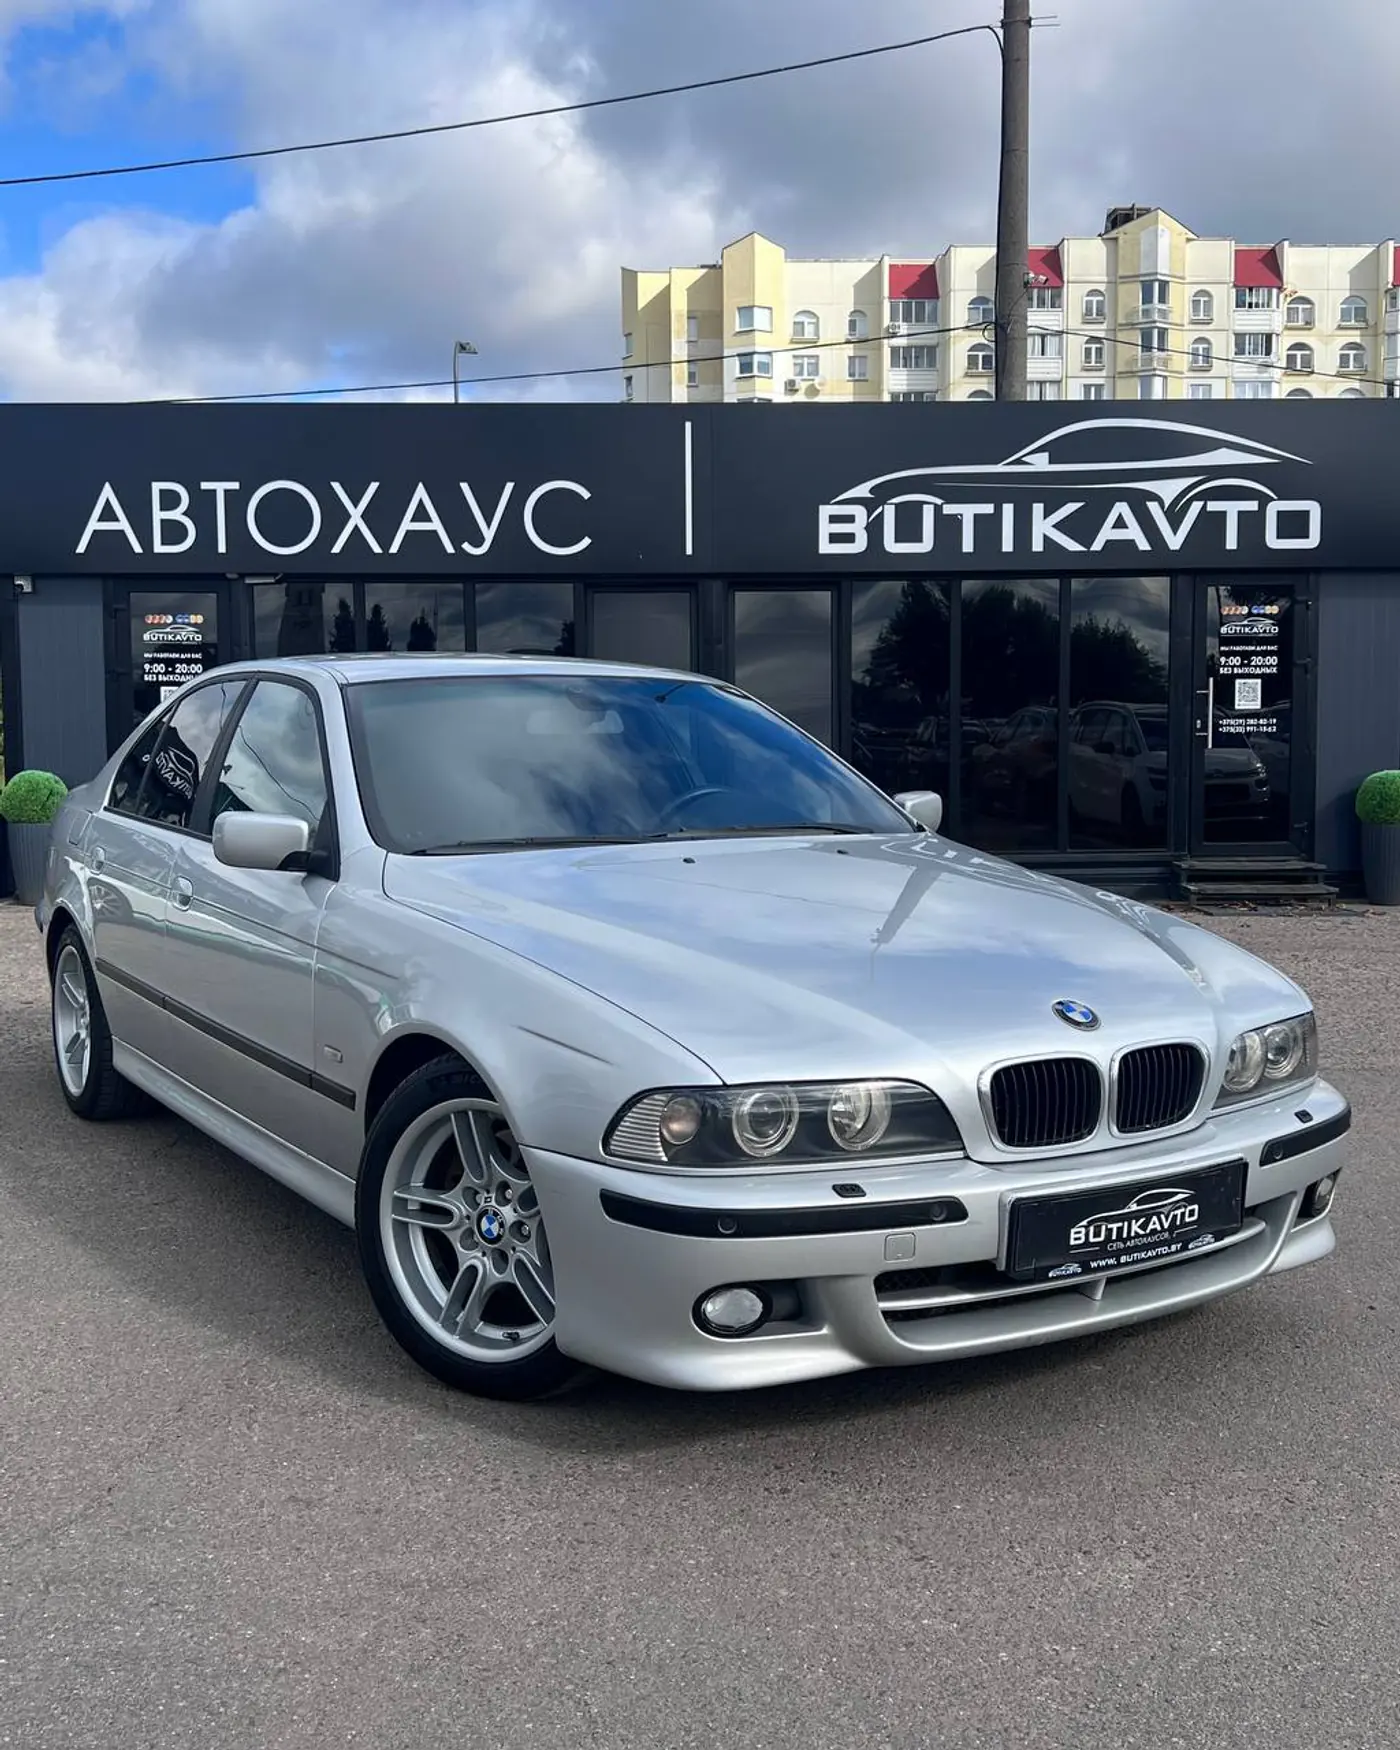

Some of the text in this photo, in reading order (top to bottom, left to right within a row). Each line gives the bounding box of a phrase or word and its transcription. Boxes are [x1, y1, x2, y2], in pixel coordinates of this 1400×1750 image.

[75, 480, 593, 556] АВТОХАУС
[818, 499, 1322, 555] BUTIKAVTO
[1220, 625, 1279, 634] BUTIKAVTO
[143, 633, 202, 641] BUTIKAVTO
[1219, 656, 1242, 666] 9:00
[1250, 656, 1278, 666] 20:00
[143, 663, 166, 673] 9:00
[175, 663, 203, 674] 20:00
[1233, 666, 1278, 675] ВЫХОДНЫХ
[1069, 1204, 1199, 1246] BUTIKAVTO
[1119, 1243, 1183, 1264] BUTIKAVTO.BY
